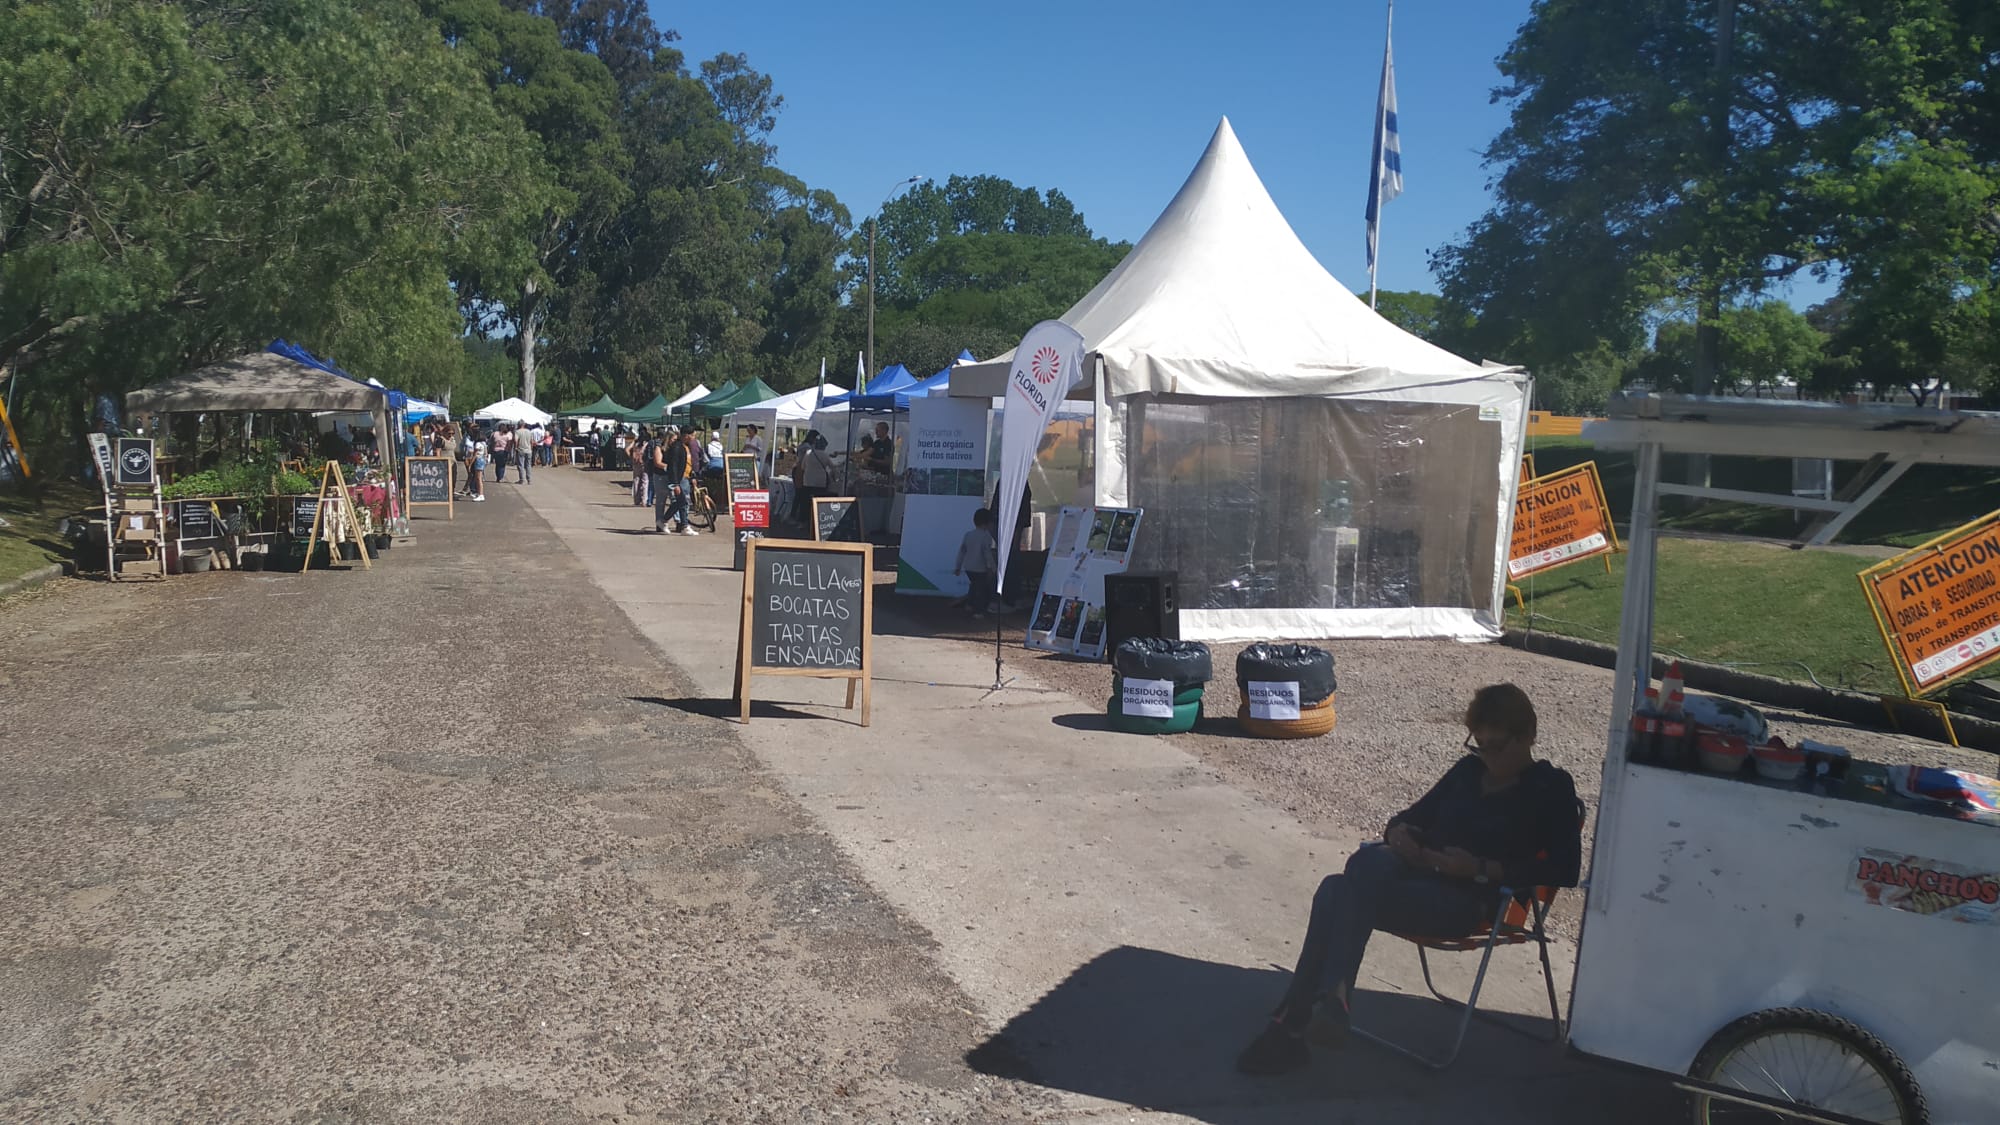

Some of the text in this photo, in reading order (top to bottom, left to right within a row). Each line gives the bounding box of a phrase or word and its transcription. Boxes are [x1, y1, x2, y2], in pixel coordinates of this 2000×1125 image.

[1015, 369, 1047, 411] FLORIDA
[917, 439, 974, 450] huerta orgánica
[922, 450, 944, 460] frutos
[945, 451, 972, 460] nativos
[1515, 482, 1581, 516] TENCION
[740, 510, 763, 522] 15%
[1540, 504, 1575, 524] SEGURIDAD
[1541, 519, 1578, 536] TRANSITO
[1523, 532, 1574, 553] TRANSPORTE
[772, 562, 841, 590] PAELLA
[1900, 536, 2000, 600] ATENCION
[770, 594, 849, 620] BOCATAS
[1898, 569, 1996, 628] OBRAS de SEGURIDAD
[1906, 591, 2000, 643] Dpto. de TRANSITO
[768, 623, 842, 646] TARTAS
[1929, 611, 2000, 649] TRANSPORTE
[765, 644, 861, 666] ENSALADAS
[1123, 686, 1169, 697] RESIDUOS
[1123, 697, 1169, 706] ORGÁNICOS
[1249, 688, 1294, 698] RESIDUOS
[1857, 857, 2000, 904] PANCHOS
